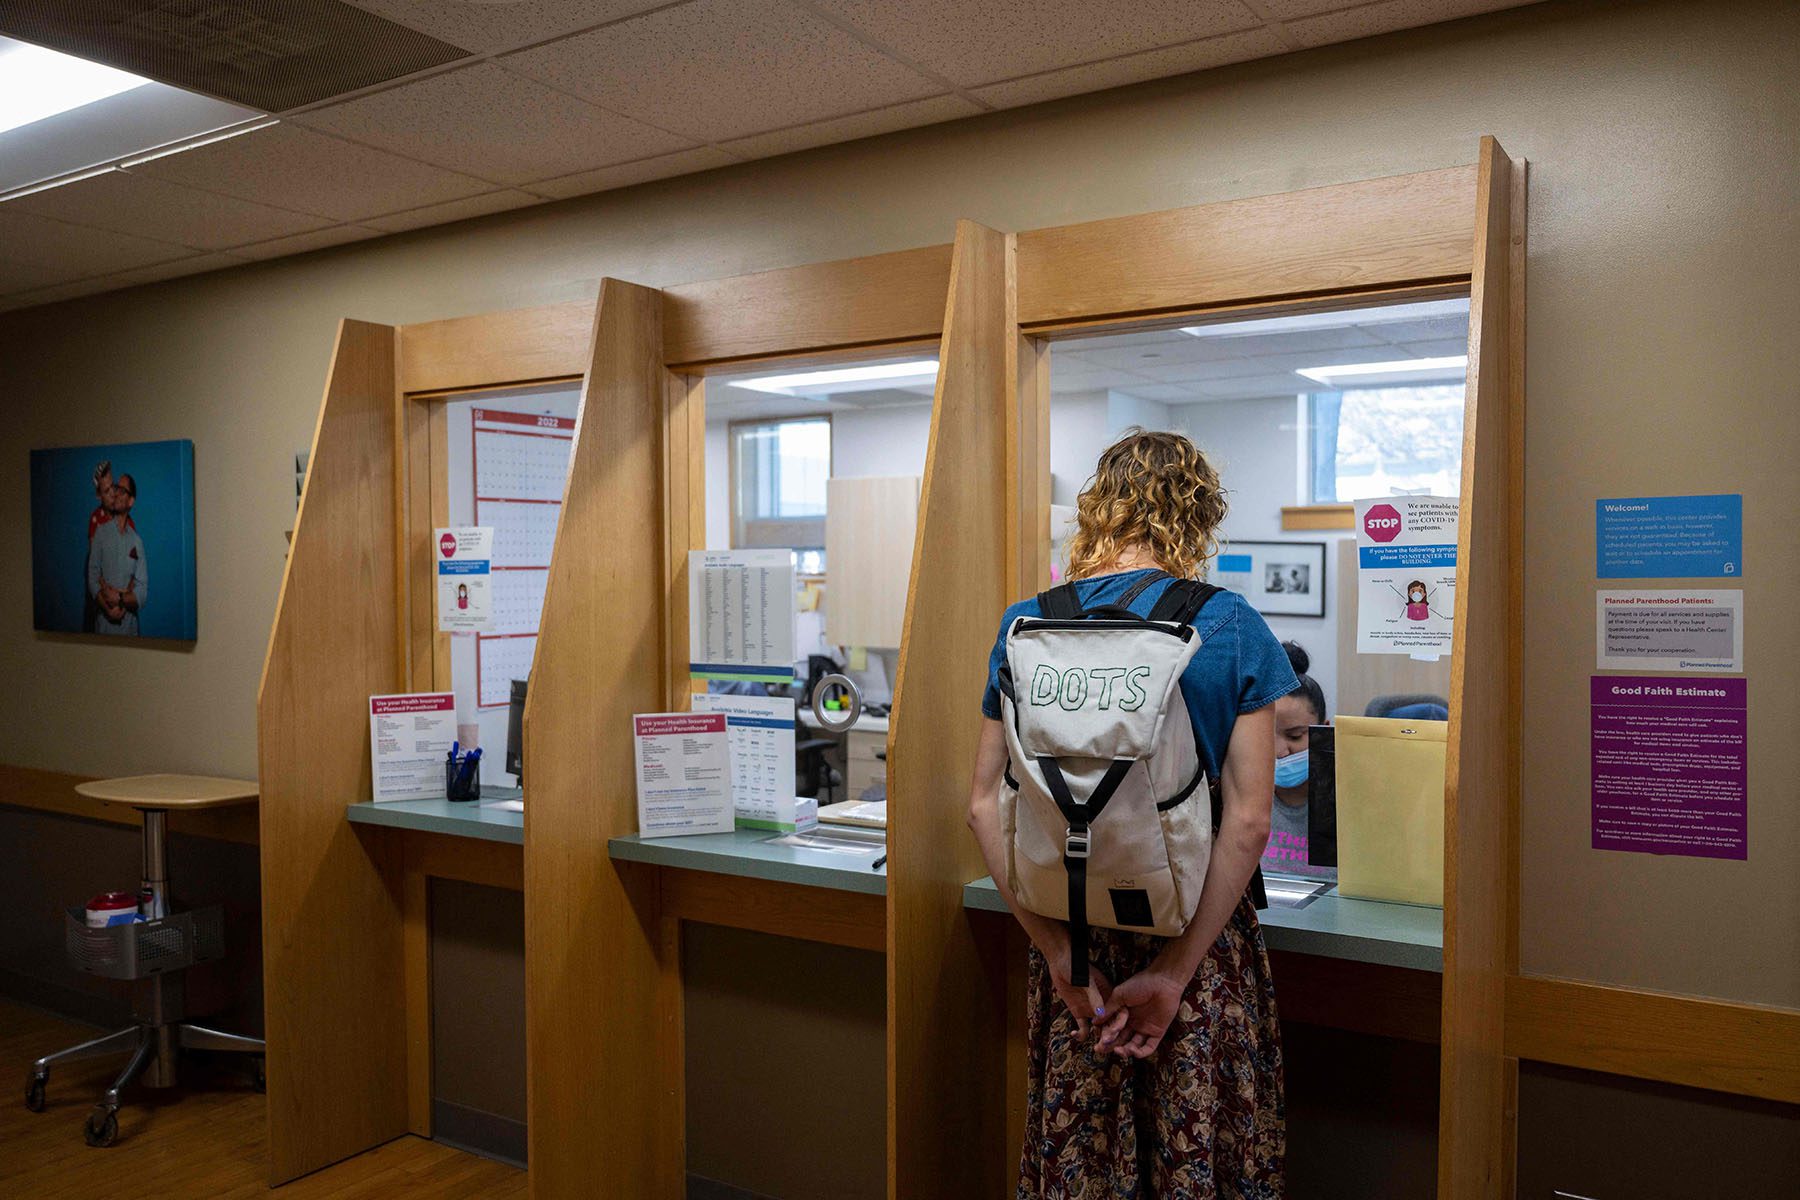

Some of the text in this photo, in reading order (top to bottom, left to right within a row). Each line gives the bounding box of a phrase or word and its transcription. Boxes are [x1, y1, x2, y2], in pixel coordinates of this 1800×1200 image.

[537, 416, 559, 427] 2022
[1605, 503, 1649, 512] Welcome!
[1418, 510, 1443, 518] patients
[1368, 518, 1398, 529] STOP
[441, 541, 456, 549] STOP
[1031, 664, 1150, 712] DOTS
[1611, 686, 1727, 697] Good Faith Estimate
[649, 725, 673, 733] Planned
[674, 724, 708, 732] Parenthood
[653, 720, 667, 728] your
